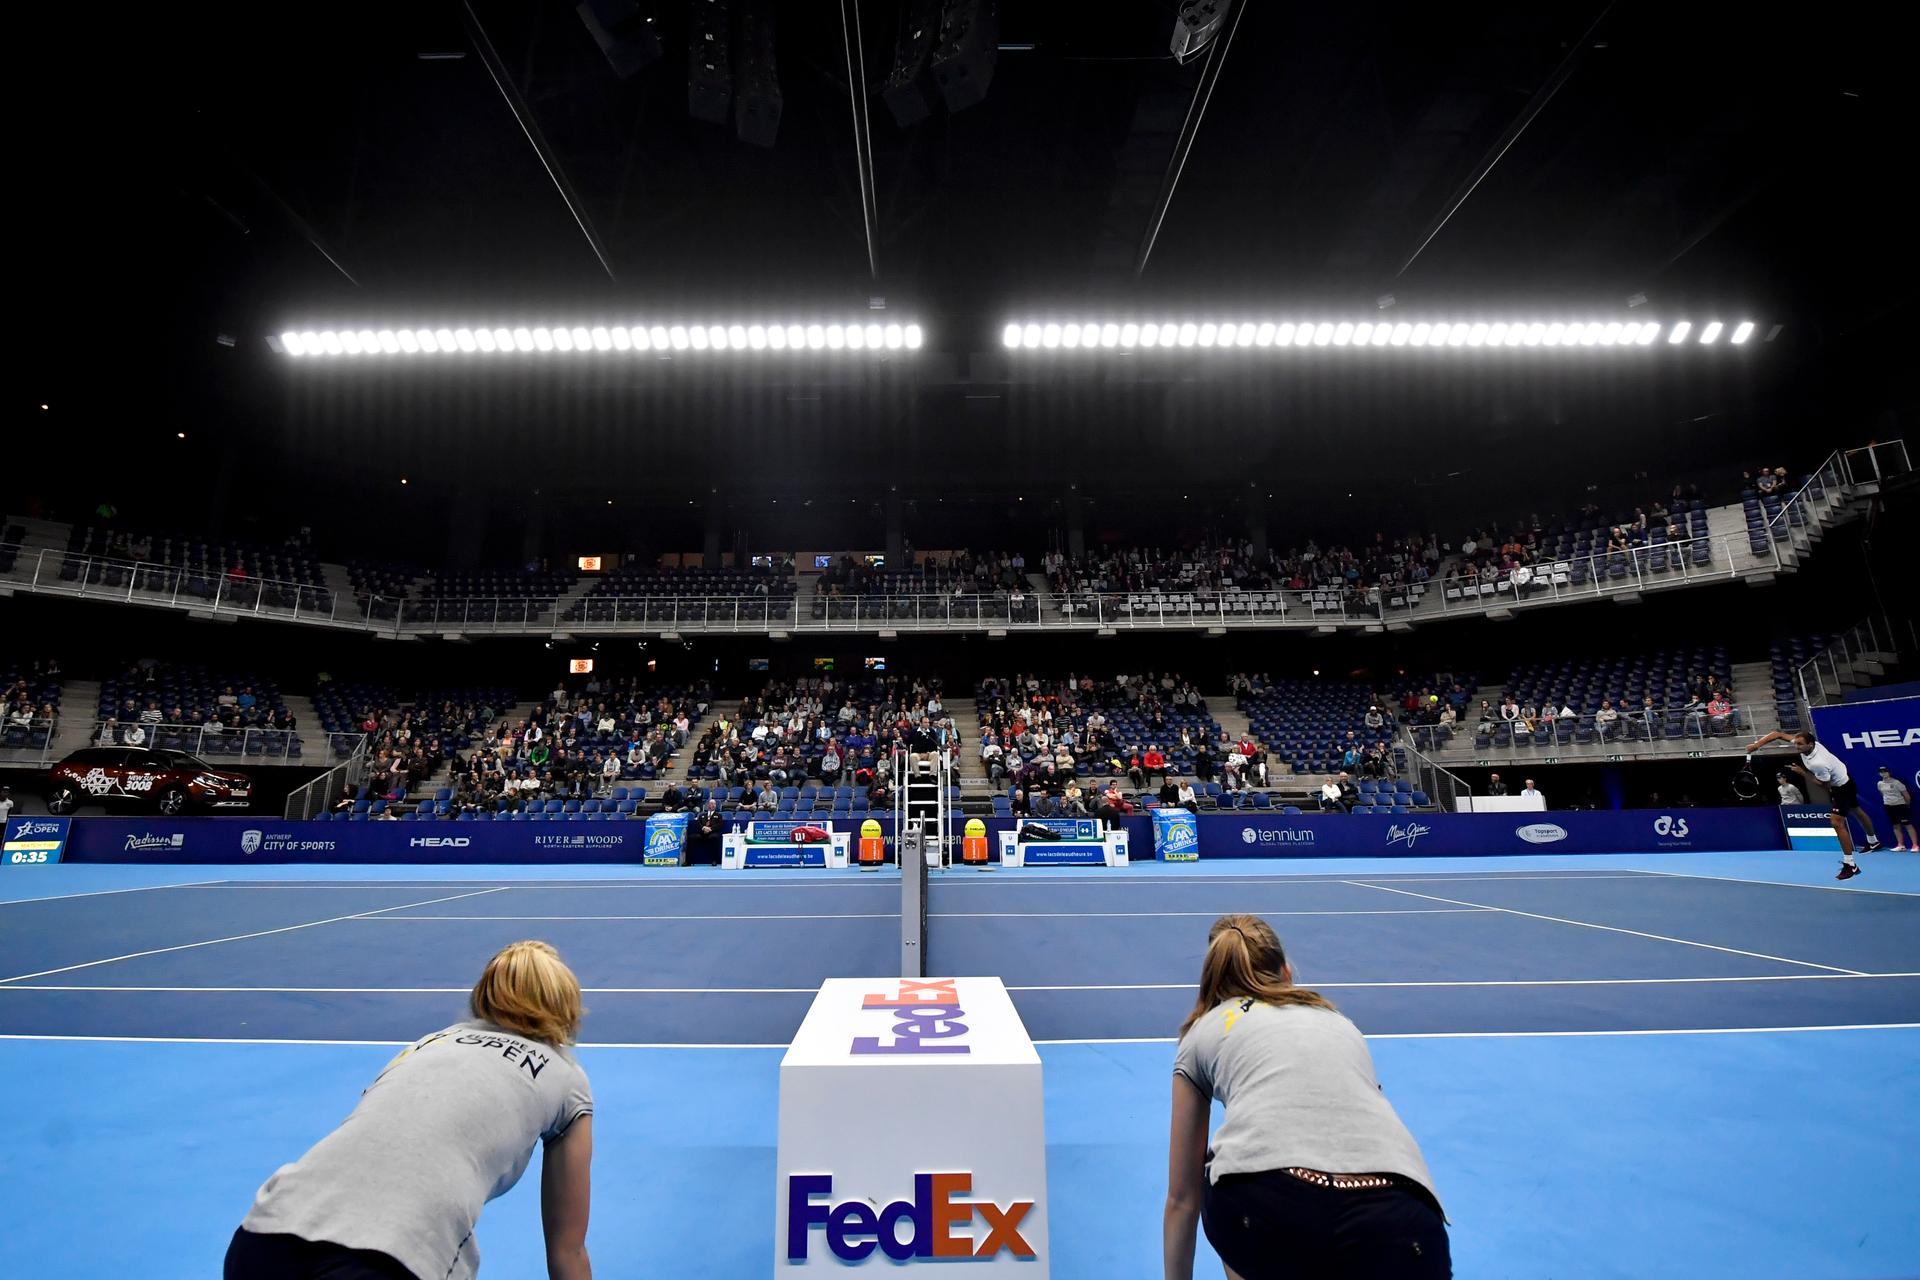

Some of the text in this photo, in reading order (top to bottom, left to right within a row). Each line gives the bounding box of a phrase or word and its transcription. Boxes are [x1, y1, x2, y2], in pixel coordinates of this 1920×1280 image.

[124, 781, 152, 791] 3008
[1654, 816, 1689, 837] G4S
[535, 836, 623, 844] RIVER WOODS
[657, 834, 672, 846] AA
[1176, 830, 1190, 842] AA
[1258, 828, 1314, 841] tennium
[263, 841, 336, 850] CITY OF SPORTS
[410, 837, 470, 847] HEAD
[11, 851, 48, 864] 0:35
[850, 978, 970, 1055] FedEx
[466, 1033, 549, 1064] EUROPEAN
[456, 1036, 544, 1080] OPEN
[787, 1172, 1037, 1261] FedEx
